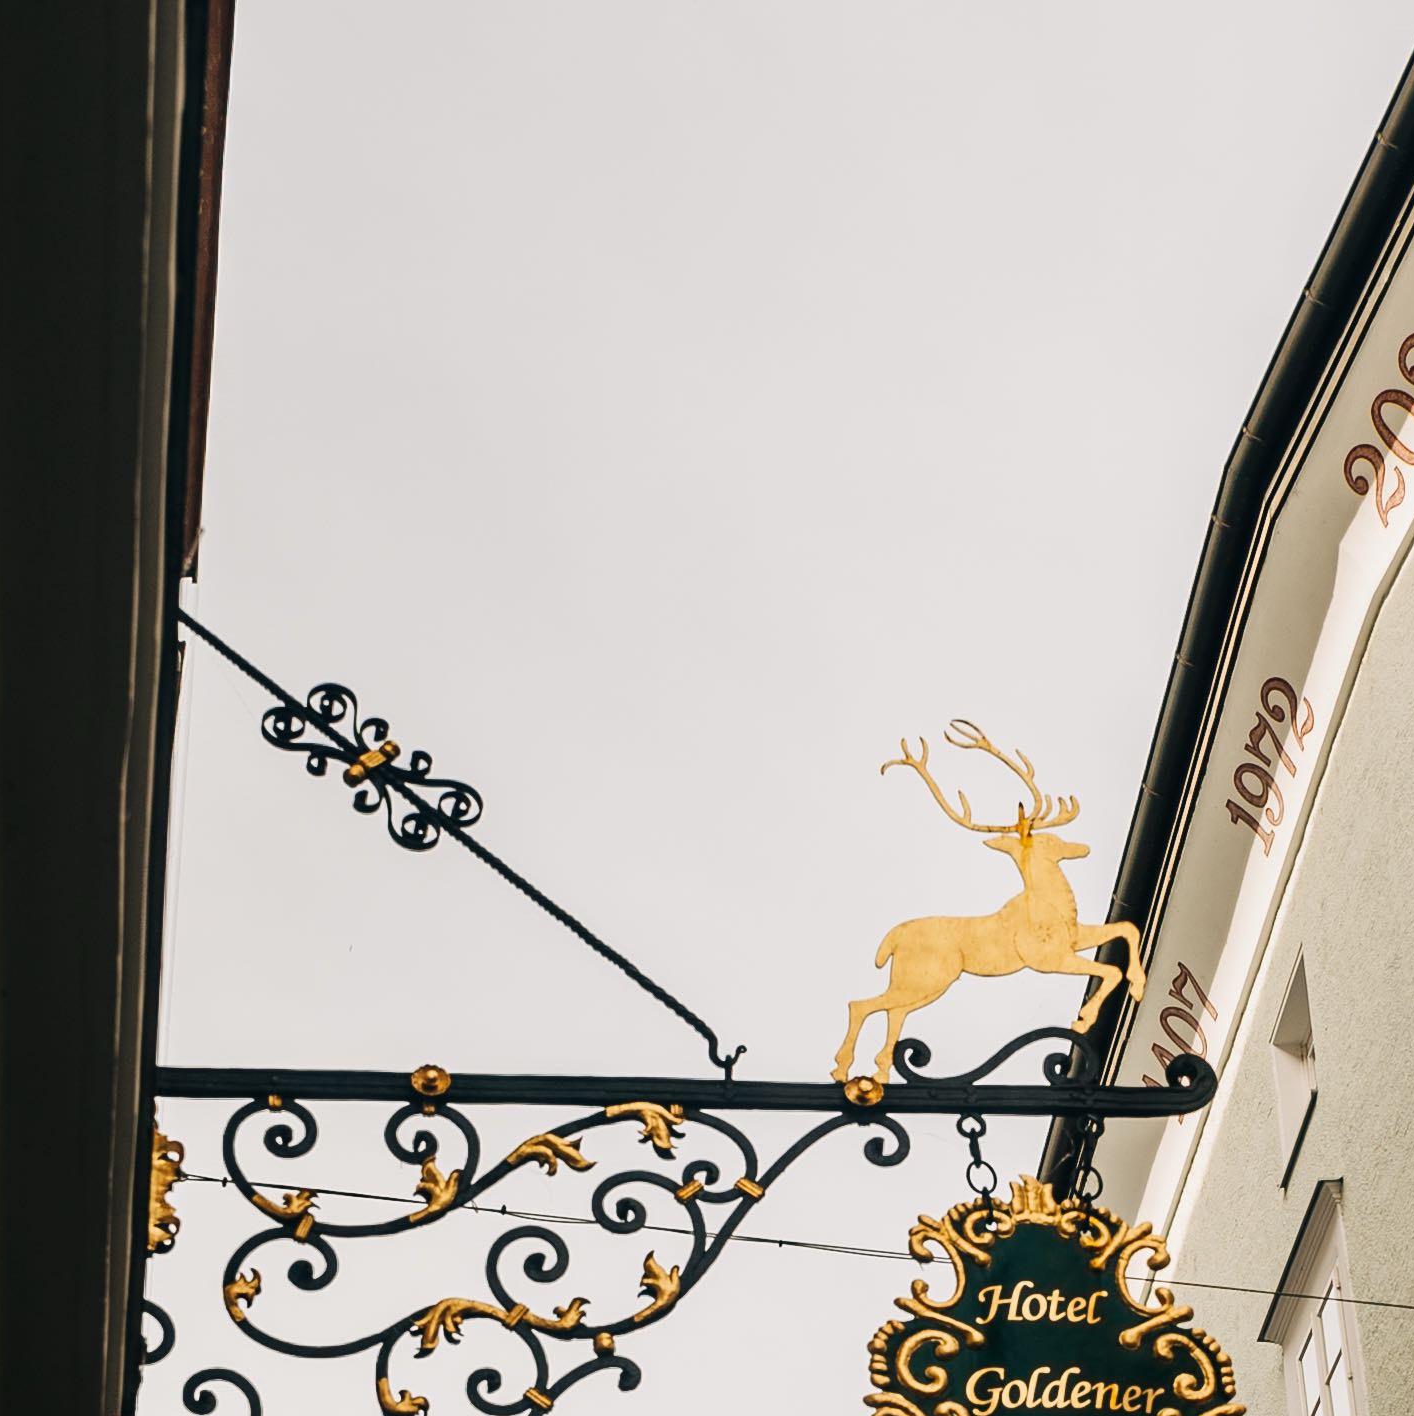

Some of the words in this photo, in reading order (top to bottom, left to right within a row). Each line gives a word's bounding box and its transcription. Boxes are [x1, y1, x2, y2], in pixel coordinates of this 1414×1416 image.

[1225, 676, 1315, 857] 1972
[1142, 961, 1219, 1125] 07
[975, 1280, 1109, 1325] Hotel
[965, 1366, 1165, 1416] Goldener
